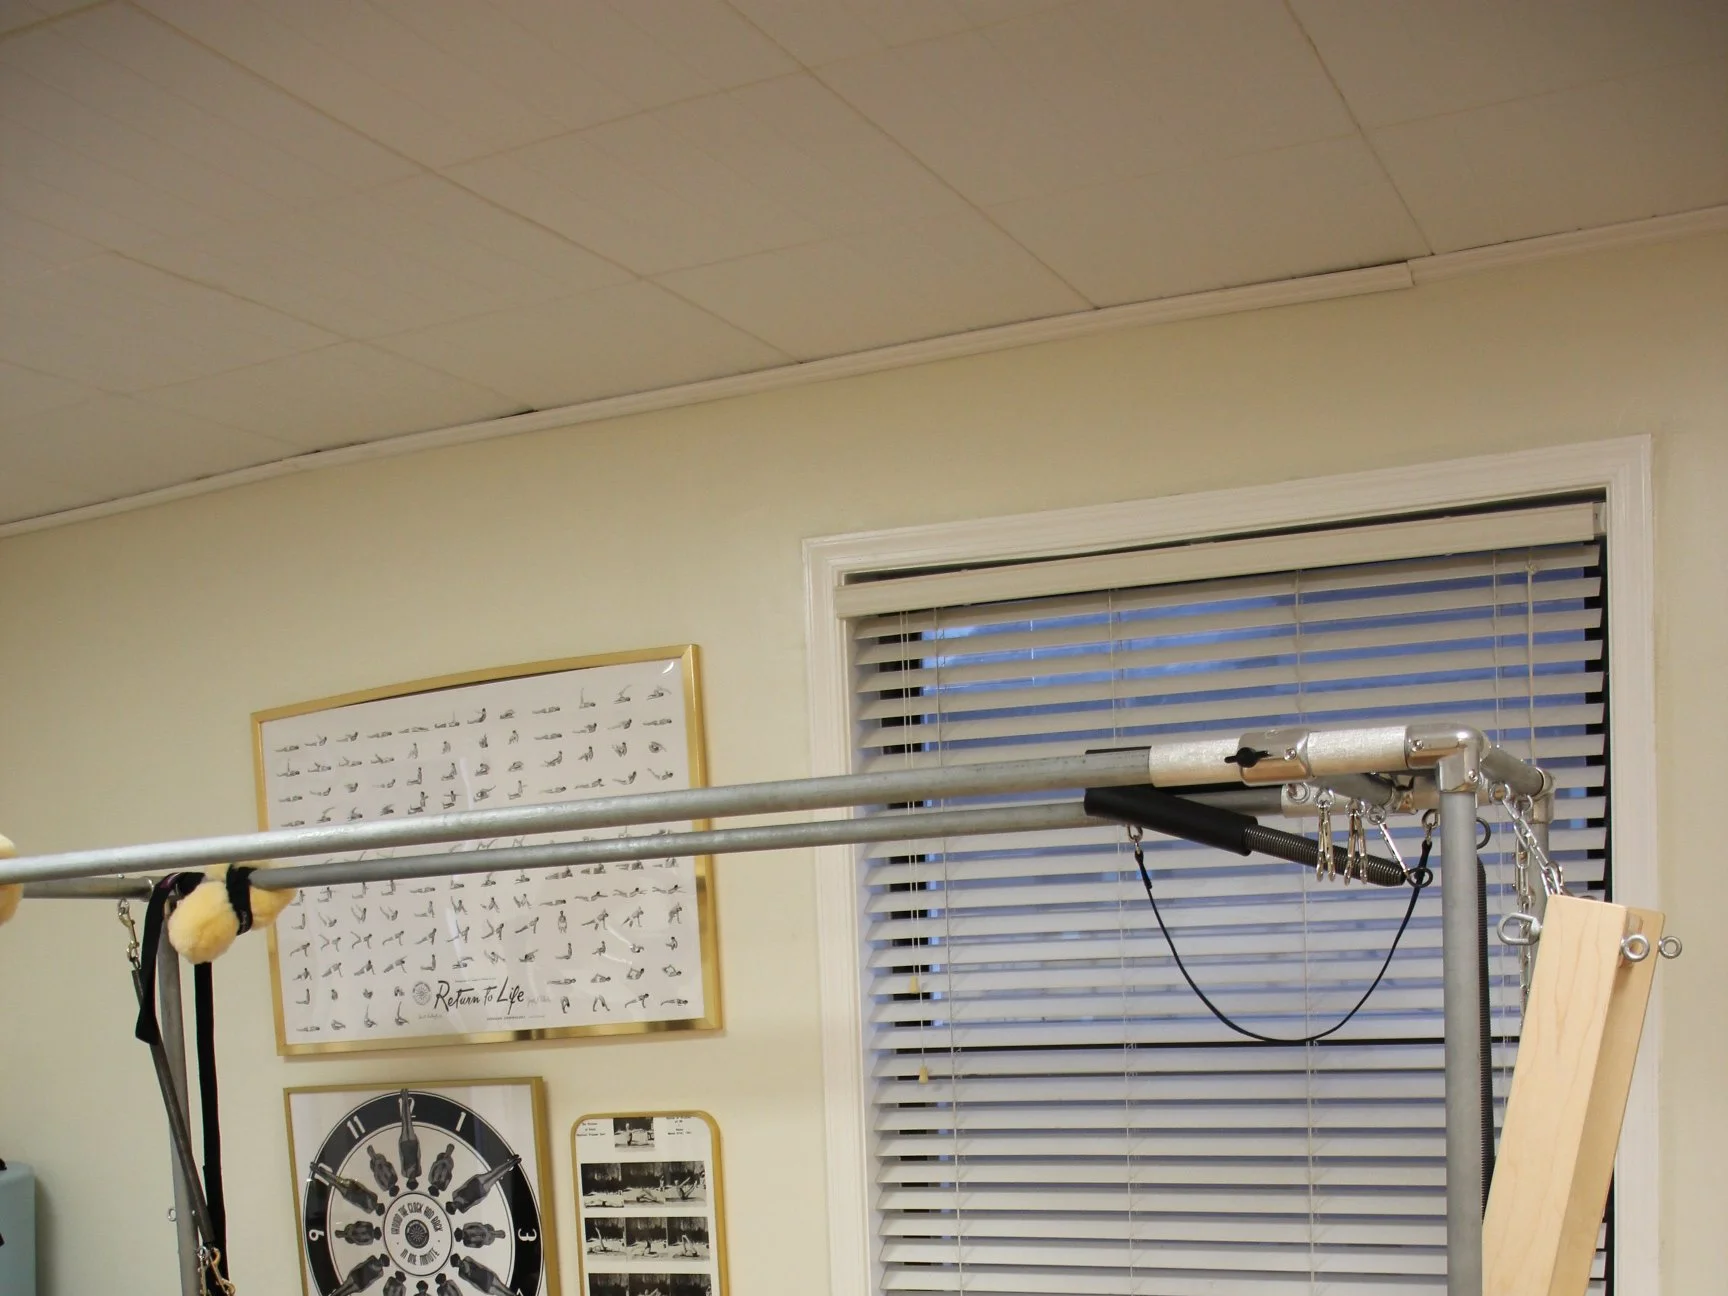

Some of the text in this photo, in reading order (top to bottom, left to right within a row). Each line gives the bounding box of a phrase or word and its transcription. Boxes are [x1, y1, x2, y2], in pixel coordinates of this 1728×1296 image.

[434, 980, 480, 1012] Return
[496, 976, 524, 1015] Life
[346, 1115, 366, 1140] 11
[455, 1111, 467, 1132] 1
[407, 1201, 424, 1214] CLOCK
[430, 1215, 444, 1232] BACK
[308, 1229, 325, 1241] 9
[517, 1227, 538, 1242] 3
